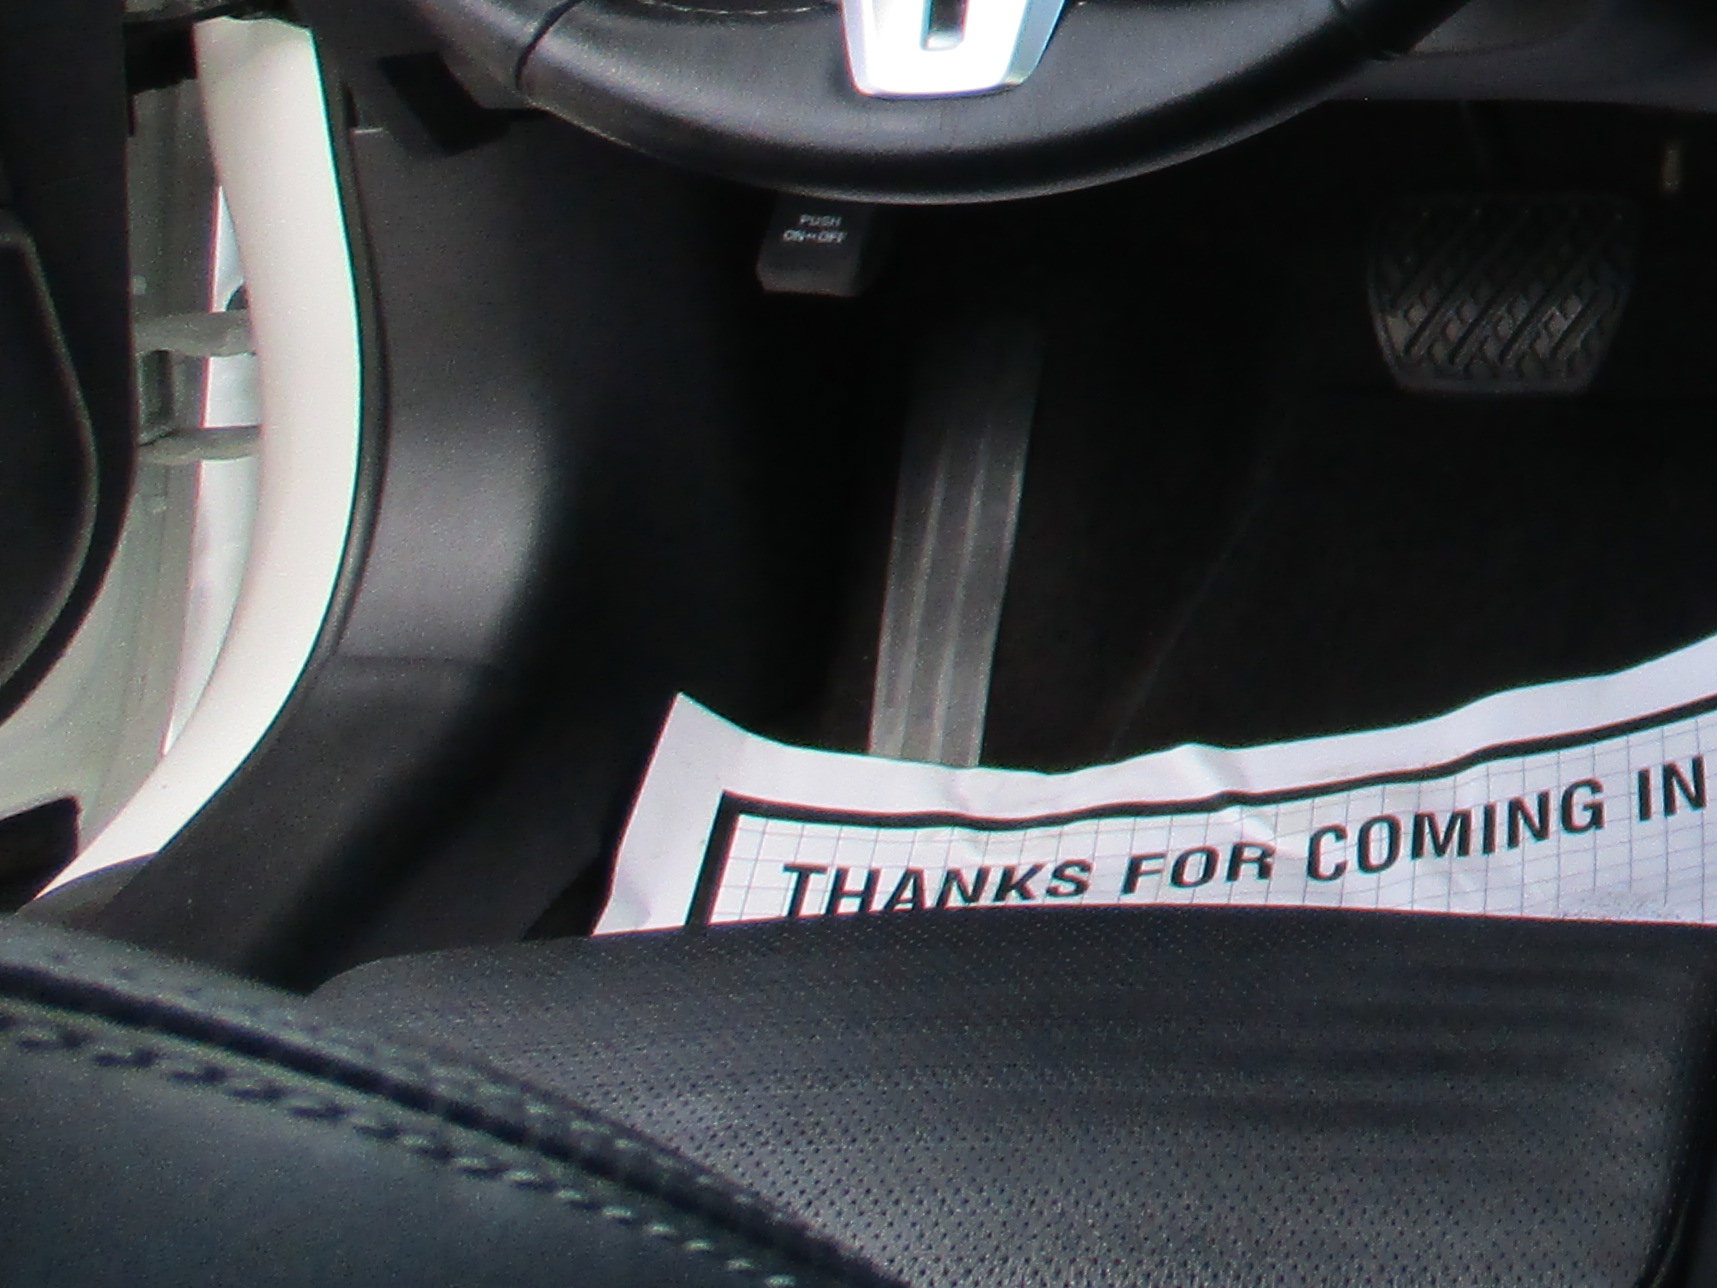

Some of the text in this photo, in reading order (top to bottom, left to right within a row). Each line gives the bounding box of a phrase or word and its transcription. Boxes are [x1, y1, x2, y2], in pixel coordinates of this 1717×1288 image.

[800, 213, 842, 227] PUSH
[783, 754, 1708, 917] THANKS FOR COMING IN
